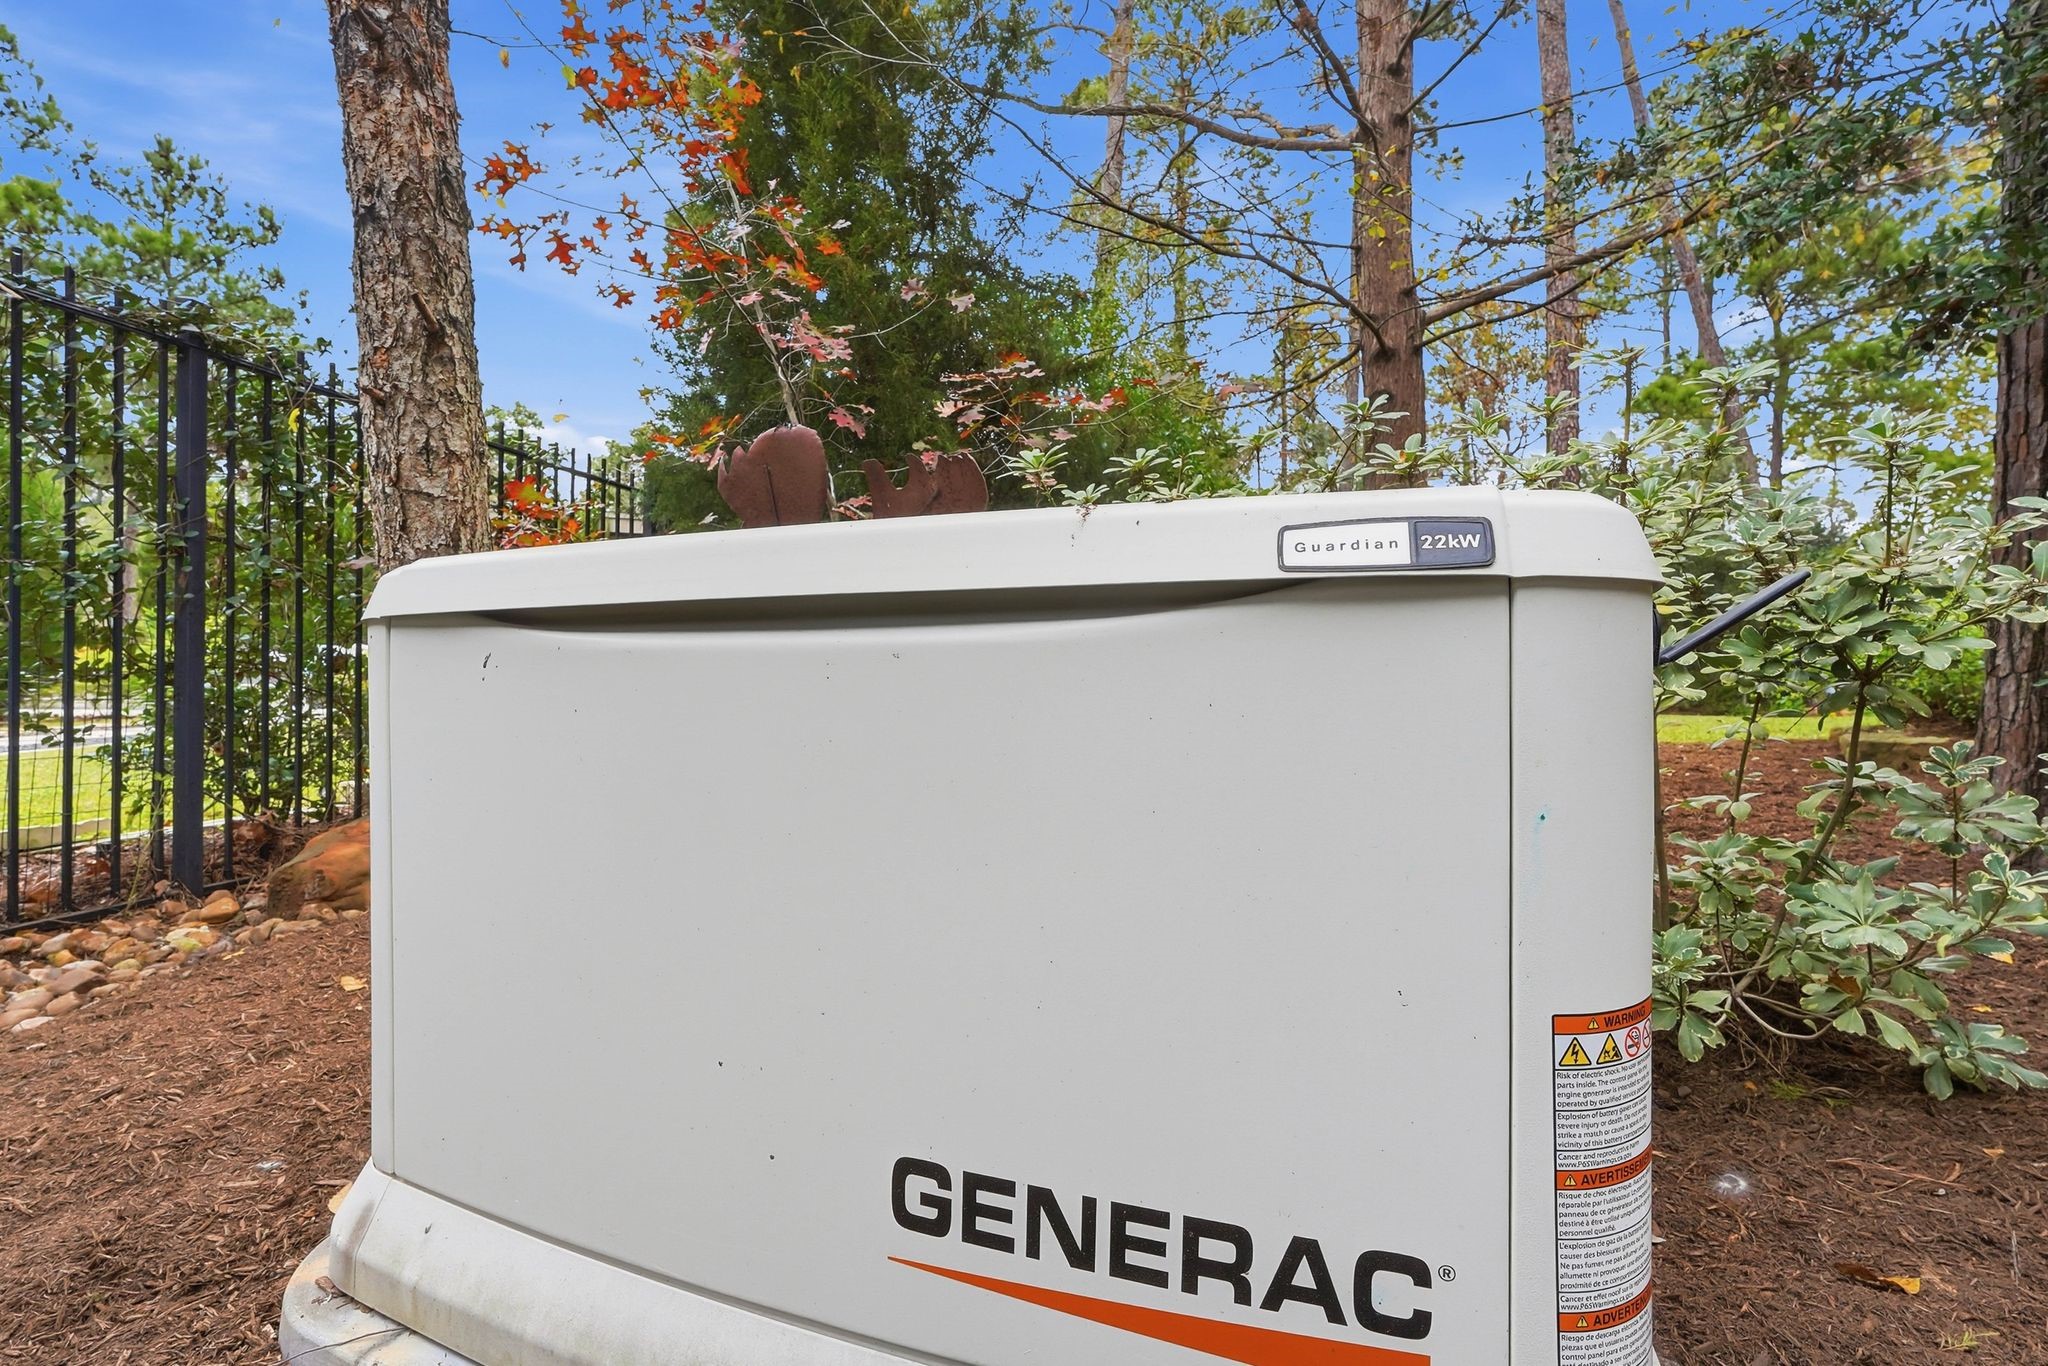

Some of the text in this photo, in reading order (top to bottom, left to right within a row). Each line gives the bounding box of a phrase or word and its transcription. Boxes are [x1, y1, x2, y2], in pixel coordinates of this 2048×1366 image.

[1294, 534, 1481, 552] Guardian 22kW
[1604, 1006, 1646, 1028] WARNING
[1581, 1070, 1603, 1078] electric
[1576, 1080, 1597, 1088] inside.
[1610, 1075, 1626, 1084] control
[1557, 1092, 1581, 1100] engine
[1582, 1088, 1612, 1098] generator
[1557, 1098, 1588, 1108] operated
[1589, 1100, 1598, 1108] by
[1598, 1094, 1622, 1106] qualified
[1557, 1112, 1590, 1120] Explosion
[1599, 1108, 1618, 1118] battery
[1581, 1121, 1599, 1130] injury
[1584, 1130, 1603, 1138] match
[1611, 1126, 1625, 1134] cause
[1557, 1140, 1582, 1149] vicinity
[1592, 1138, 1603, 1146] this
[1604, 1134, 1622, 1145] battery
[1584, 1152, 1596, 1160] and
[1597, 1144, 1629, 1158] reproductive
[1581, 1152, 1650, 1186] AVERTISSEME
[1558, 1200, 1591, 1209] réparable
[1592, 1200, 1602, 1209] par
[1559, 1220, 1584, 1228] destiné
[1591, 1216, 1604, 1226] être
[1560, 1230, 1593, 1238] personnel
[892, 1156, 1432, 1340] GENERAC
[1560, 1241, 1596, 1250] L'explosion
[1606, 1238, 1616, 1246] gaz
[1596, 1246, 1621, 1257] blessures
[1572, 1262, 1584, 1270] pas
[1613, 1254, 1622, 1264] pas
[1560, 1272, 1592, 1280] allumette
[1600, 1264, 1626, 1277] provoquer
[1560, 1282, 1592, 1290] proximité
[1594, 1291, 1608, 1300] effet
[1594, 1289, 1651, 1326] ADVERTEN
[1595, 1329, 1620, 1340] descarga
[1562, 1352, 1586, 1360] control
[1588, 1350, 1605, 1360] panel
[1606, 1346, 1618, 1357] para
